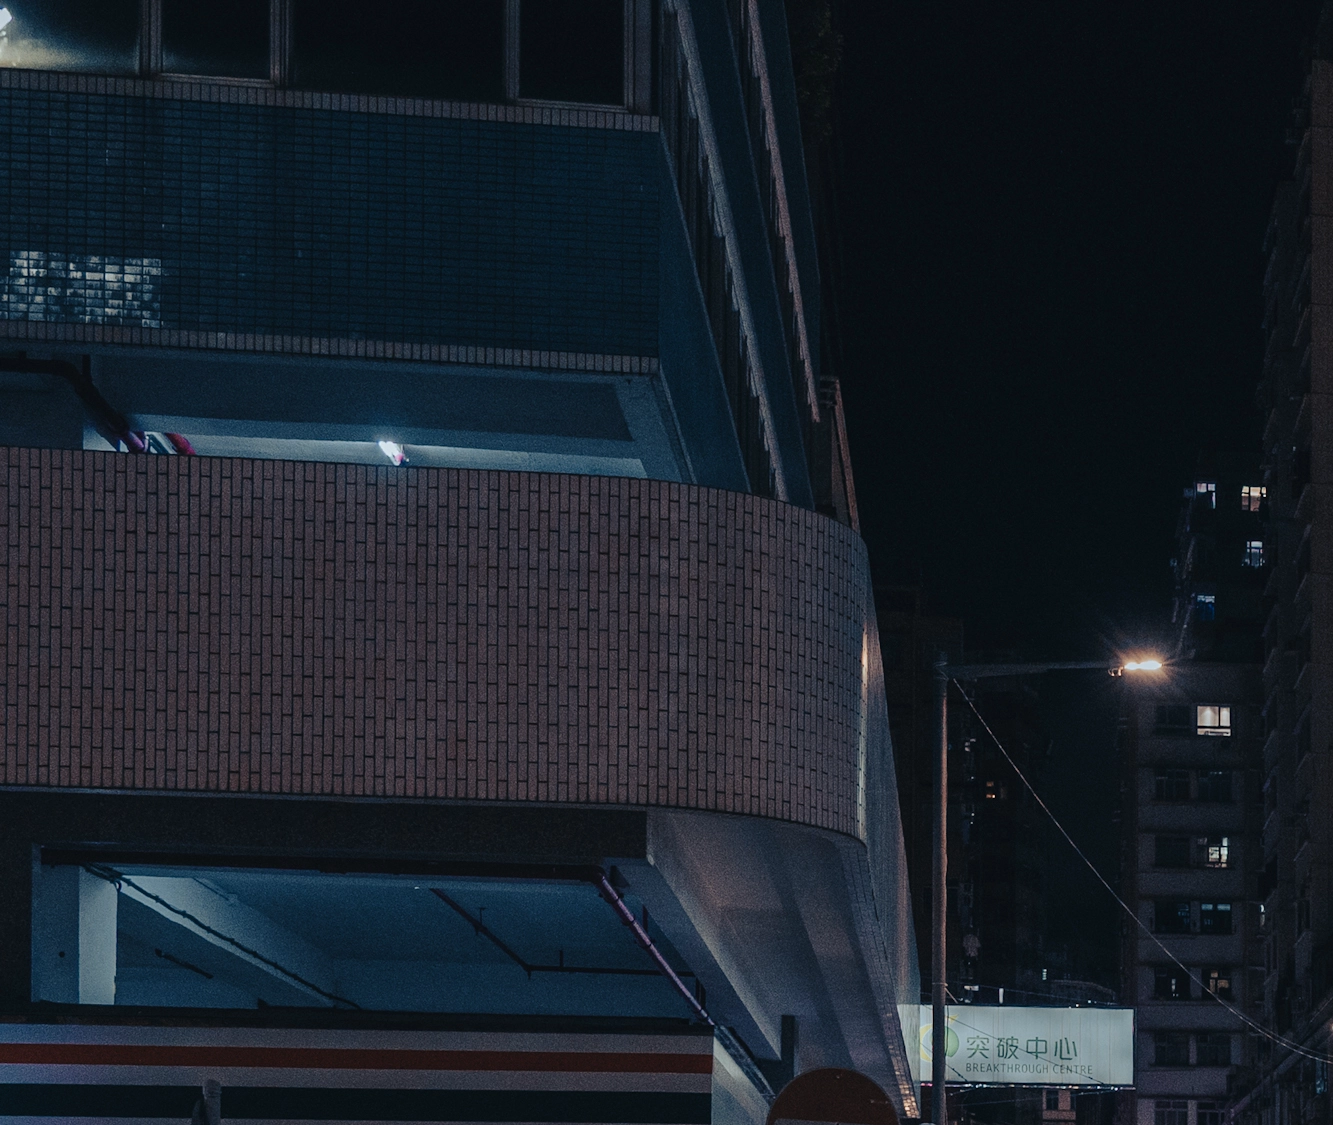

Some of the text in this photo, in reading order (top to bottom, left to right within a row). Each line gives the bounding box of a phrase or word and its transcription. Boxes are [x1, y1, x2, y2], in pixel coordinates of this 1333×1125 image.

[967, 1036, 1078, 1061] 突破中心
[966, 1062, 1093, 1075] BREAKTHROUGH CENTRE
